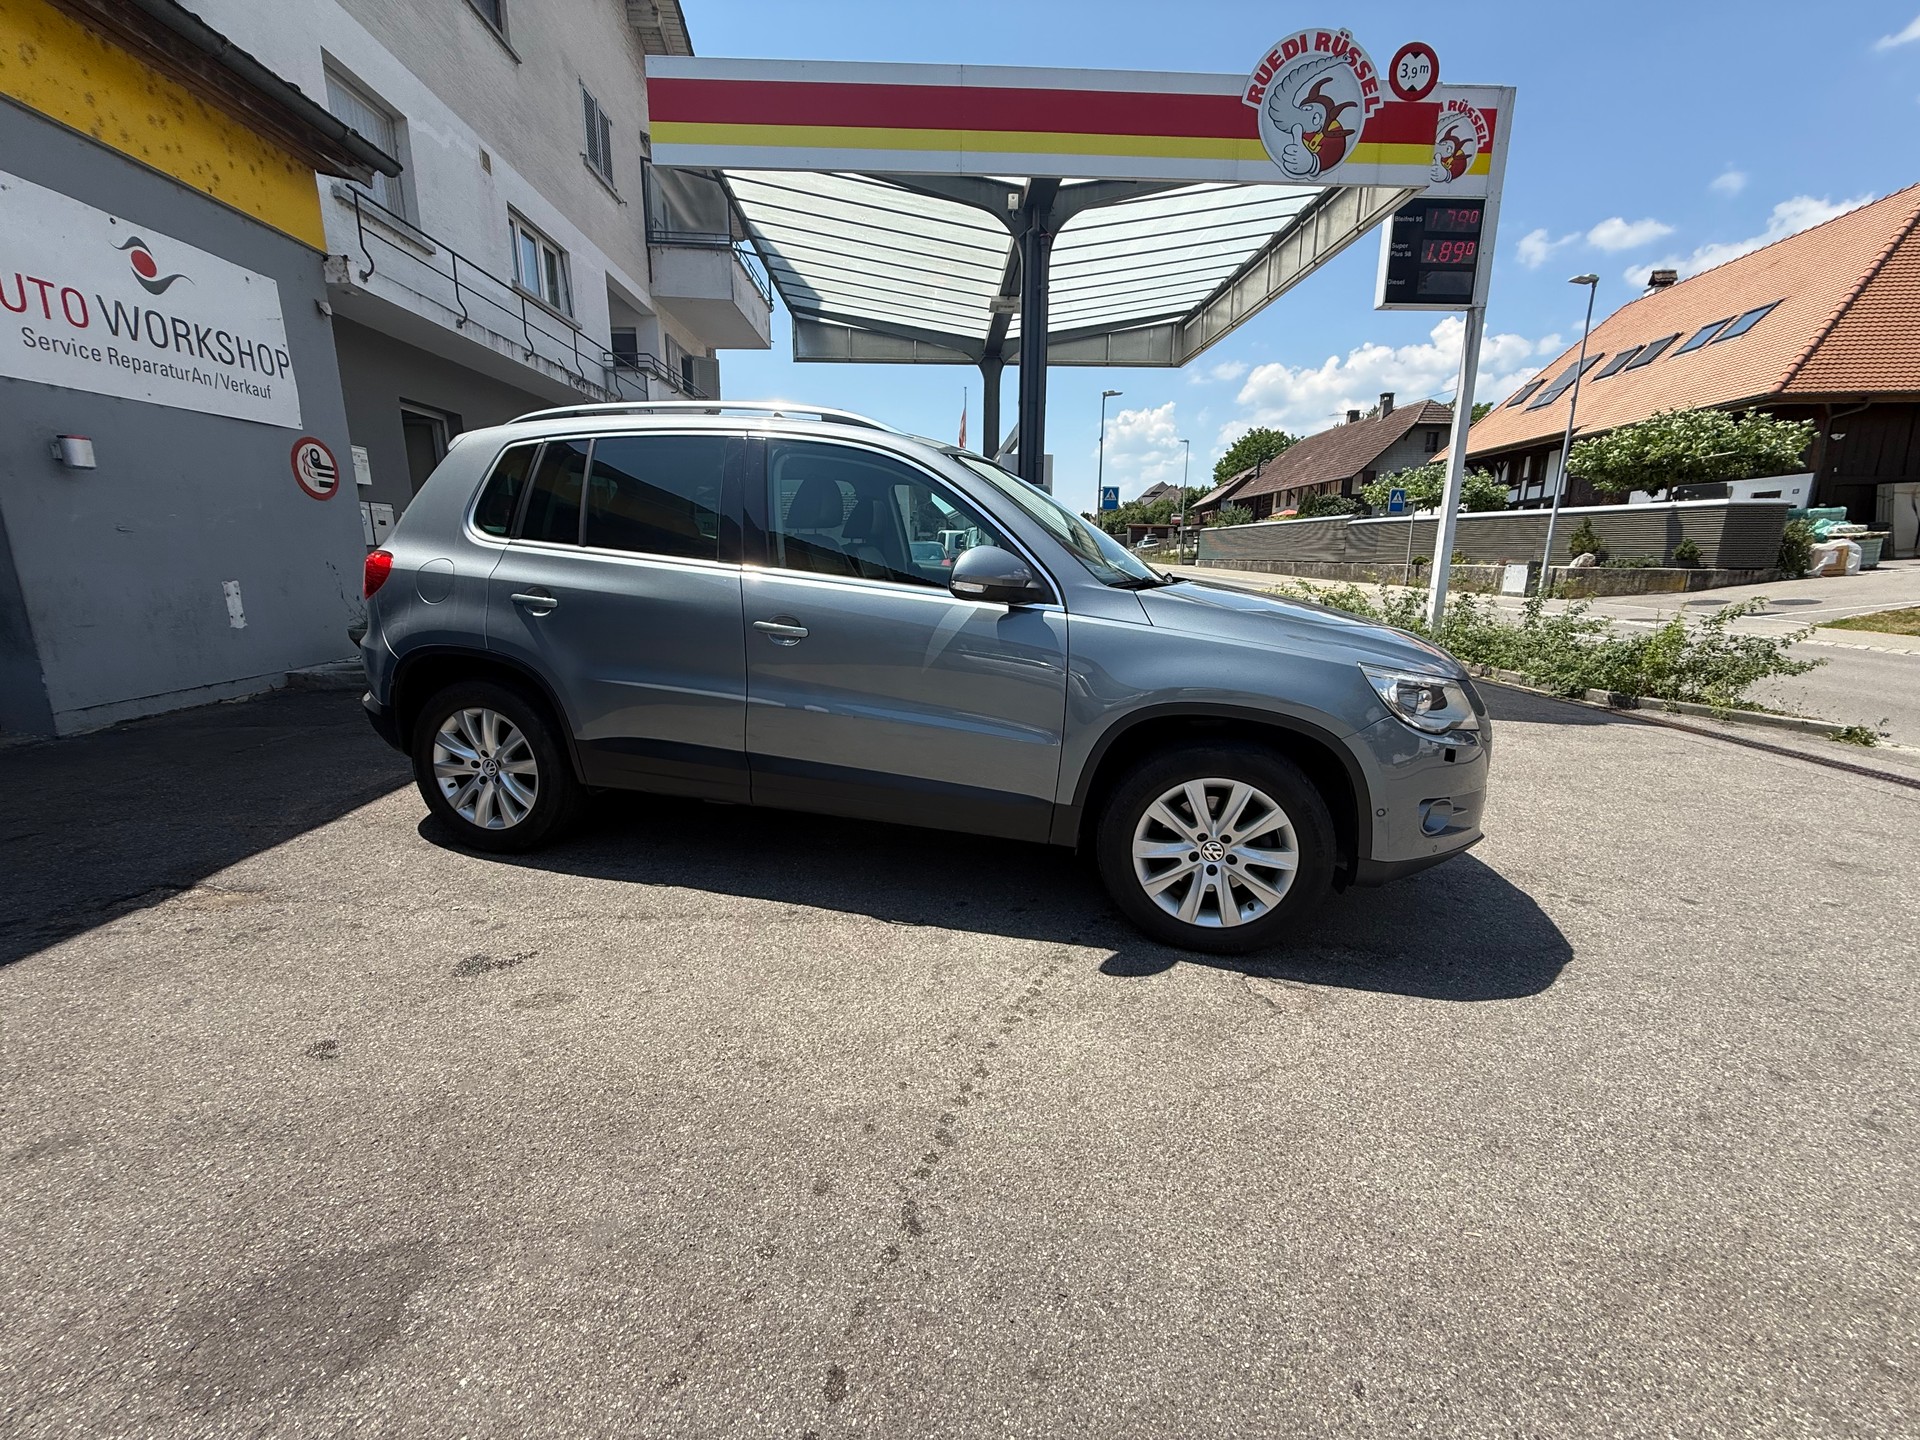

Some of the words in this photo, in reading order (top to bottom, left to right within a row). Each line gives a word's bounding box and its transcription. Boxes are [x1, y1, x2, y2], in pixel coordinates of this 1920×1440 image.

[1246, 33, 1309, 105] RUEDI
[1314, 30, 1380, 114] RÜSSEL
[1447, 98, 1488, 145] RÜSSEL
[1391, 242, 1409, 250] Super
[21, 326, 102, 363] Service
[95, 294, 290, 380] WORKSHOP
